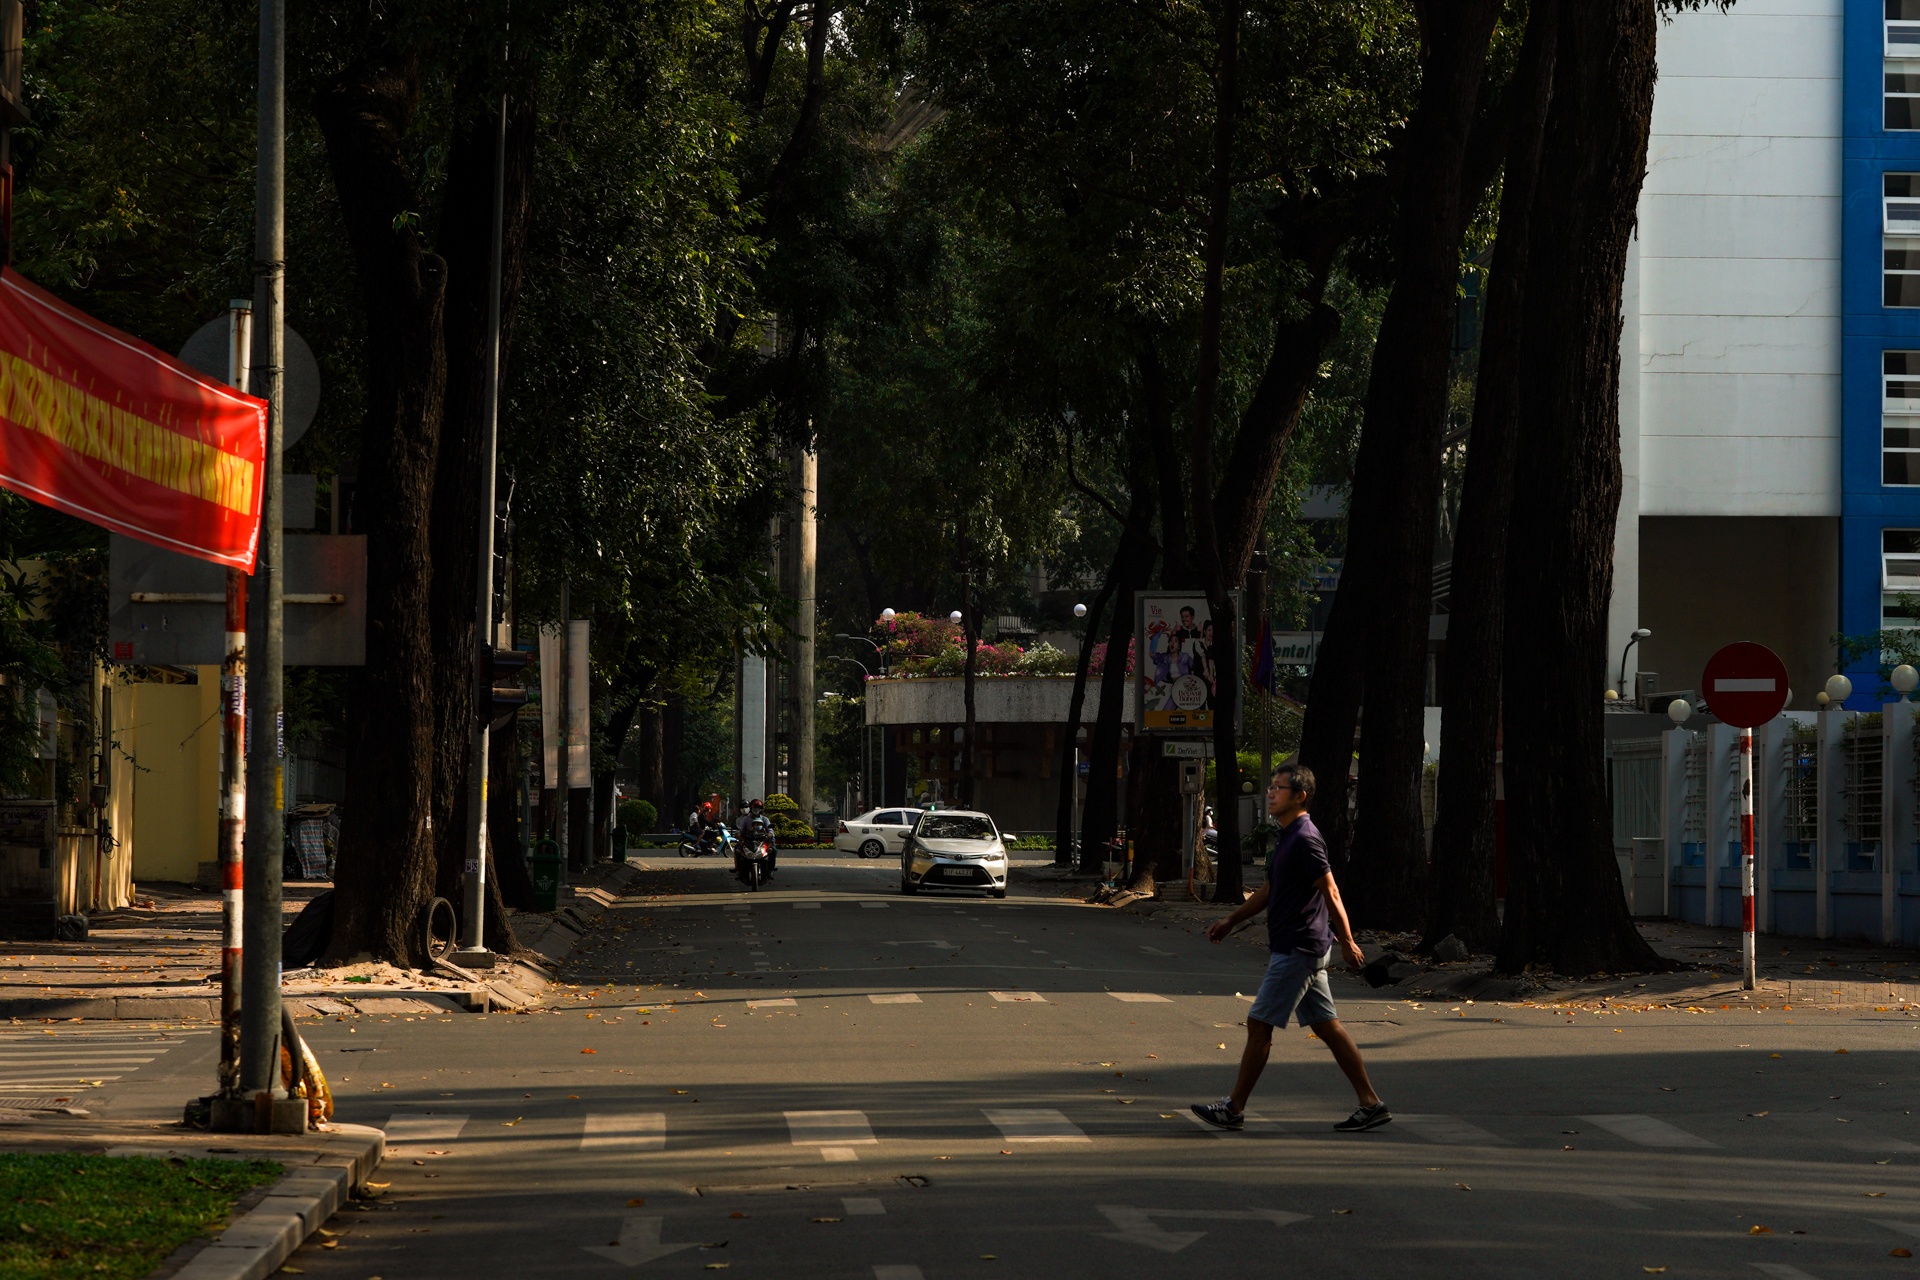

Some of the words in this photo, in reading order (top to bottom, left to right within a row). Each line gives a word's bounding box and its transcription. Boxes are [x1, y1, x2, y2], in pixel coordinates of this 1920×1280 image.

[1150, 605, 1162, 615] Vie
[1273, 644, 1311, 659] ental
[1214, 1111, 1229, 1123] N
[1352, 1111, 1369, 1123] N
